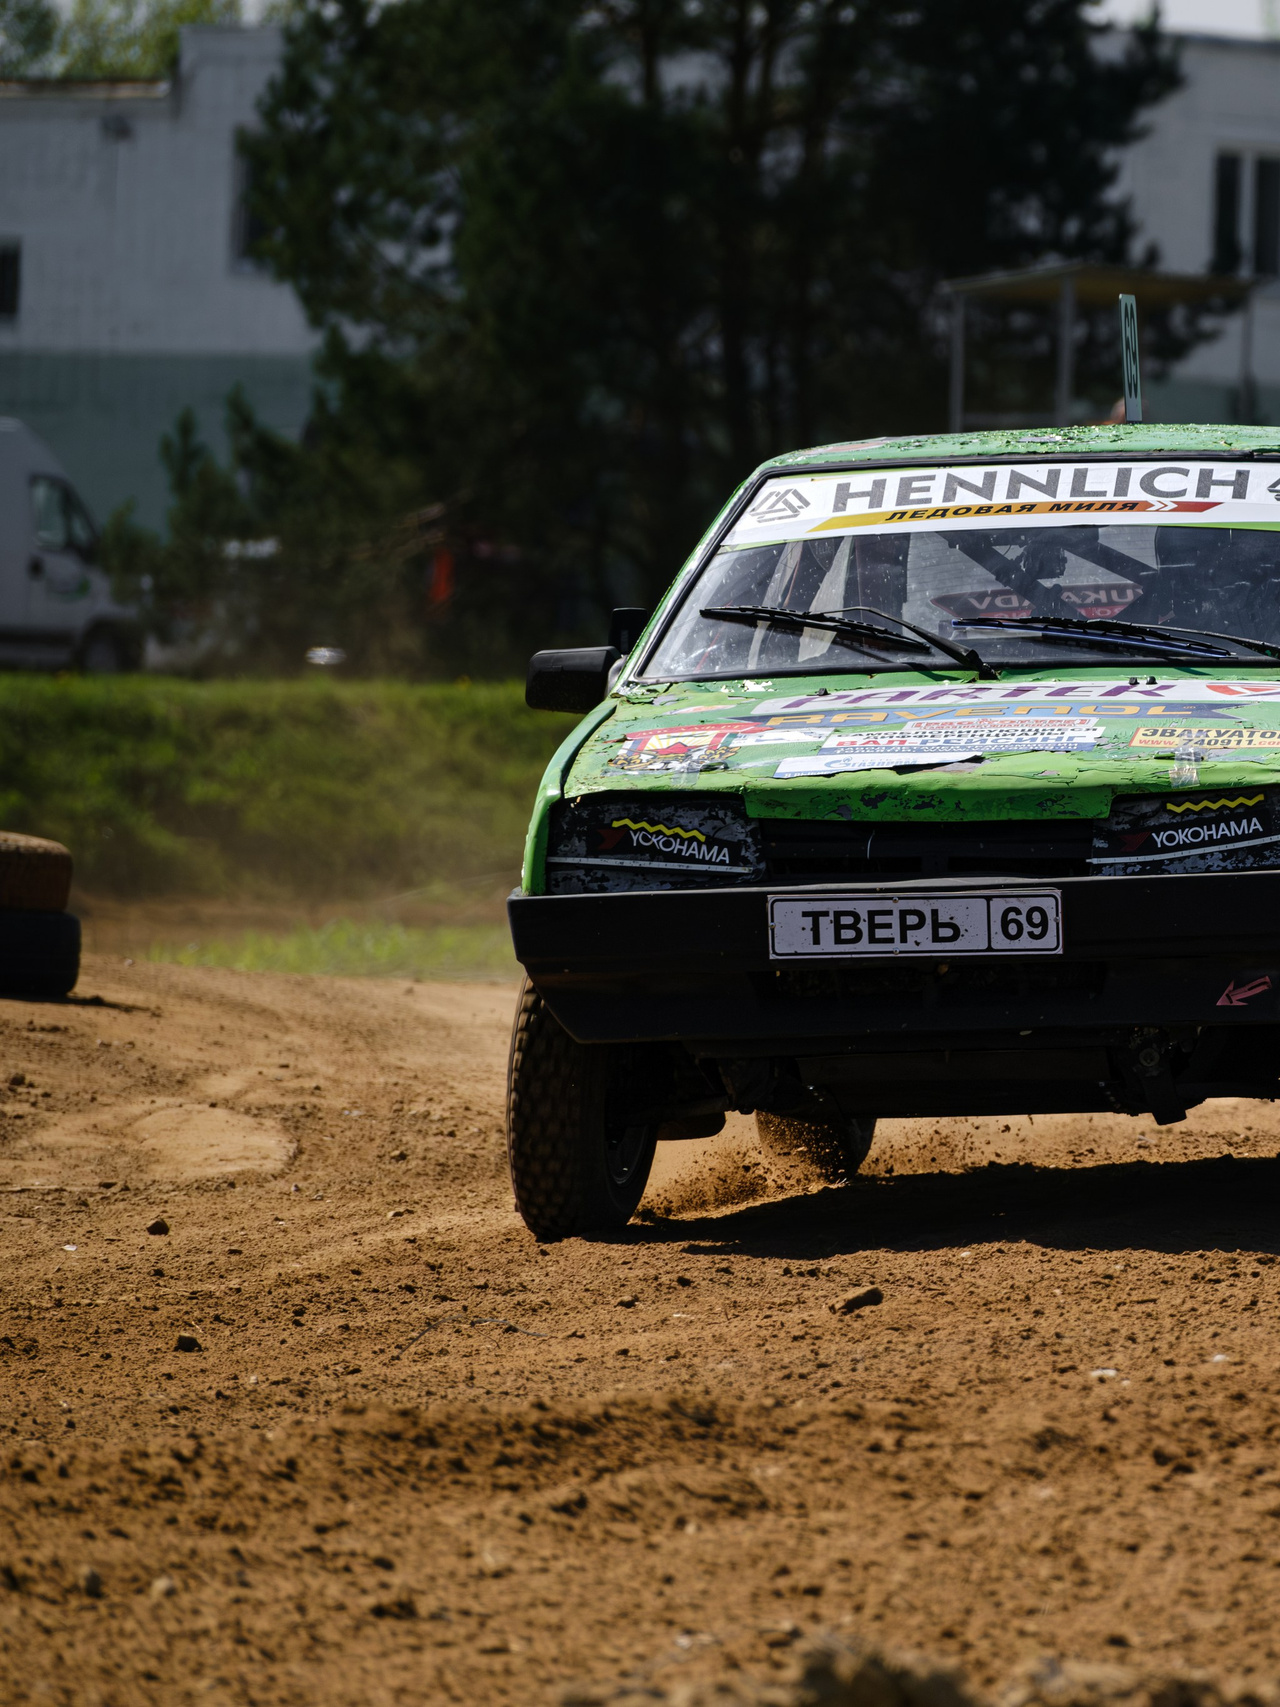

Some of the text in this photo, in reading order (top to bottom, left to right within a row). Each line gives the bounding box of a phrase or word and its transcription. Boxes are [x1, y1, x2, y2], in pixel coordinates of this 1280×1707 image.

[1124, 302, 1138, 399] 69
[832, 466, 1250, 513] HENNLICH
[884, 502, 1139, 521] ЛЕДОВАЯ МИЛЯ
[780, 684, 1177, 709] PARTEK
[767, 705, 1193, 727] RAVENOL
[837, 728, 1098, 737] САМОБЛОКИРУЮЩИЕСЯ
[629, 830, 730, 864] YOKOHAMA
[1152, 817, 1263, 848] YOKOHAMA
[801, 906, 1049, 945] ТВЕРЬ 69
